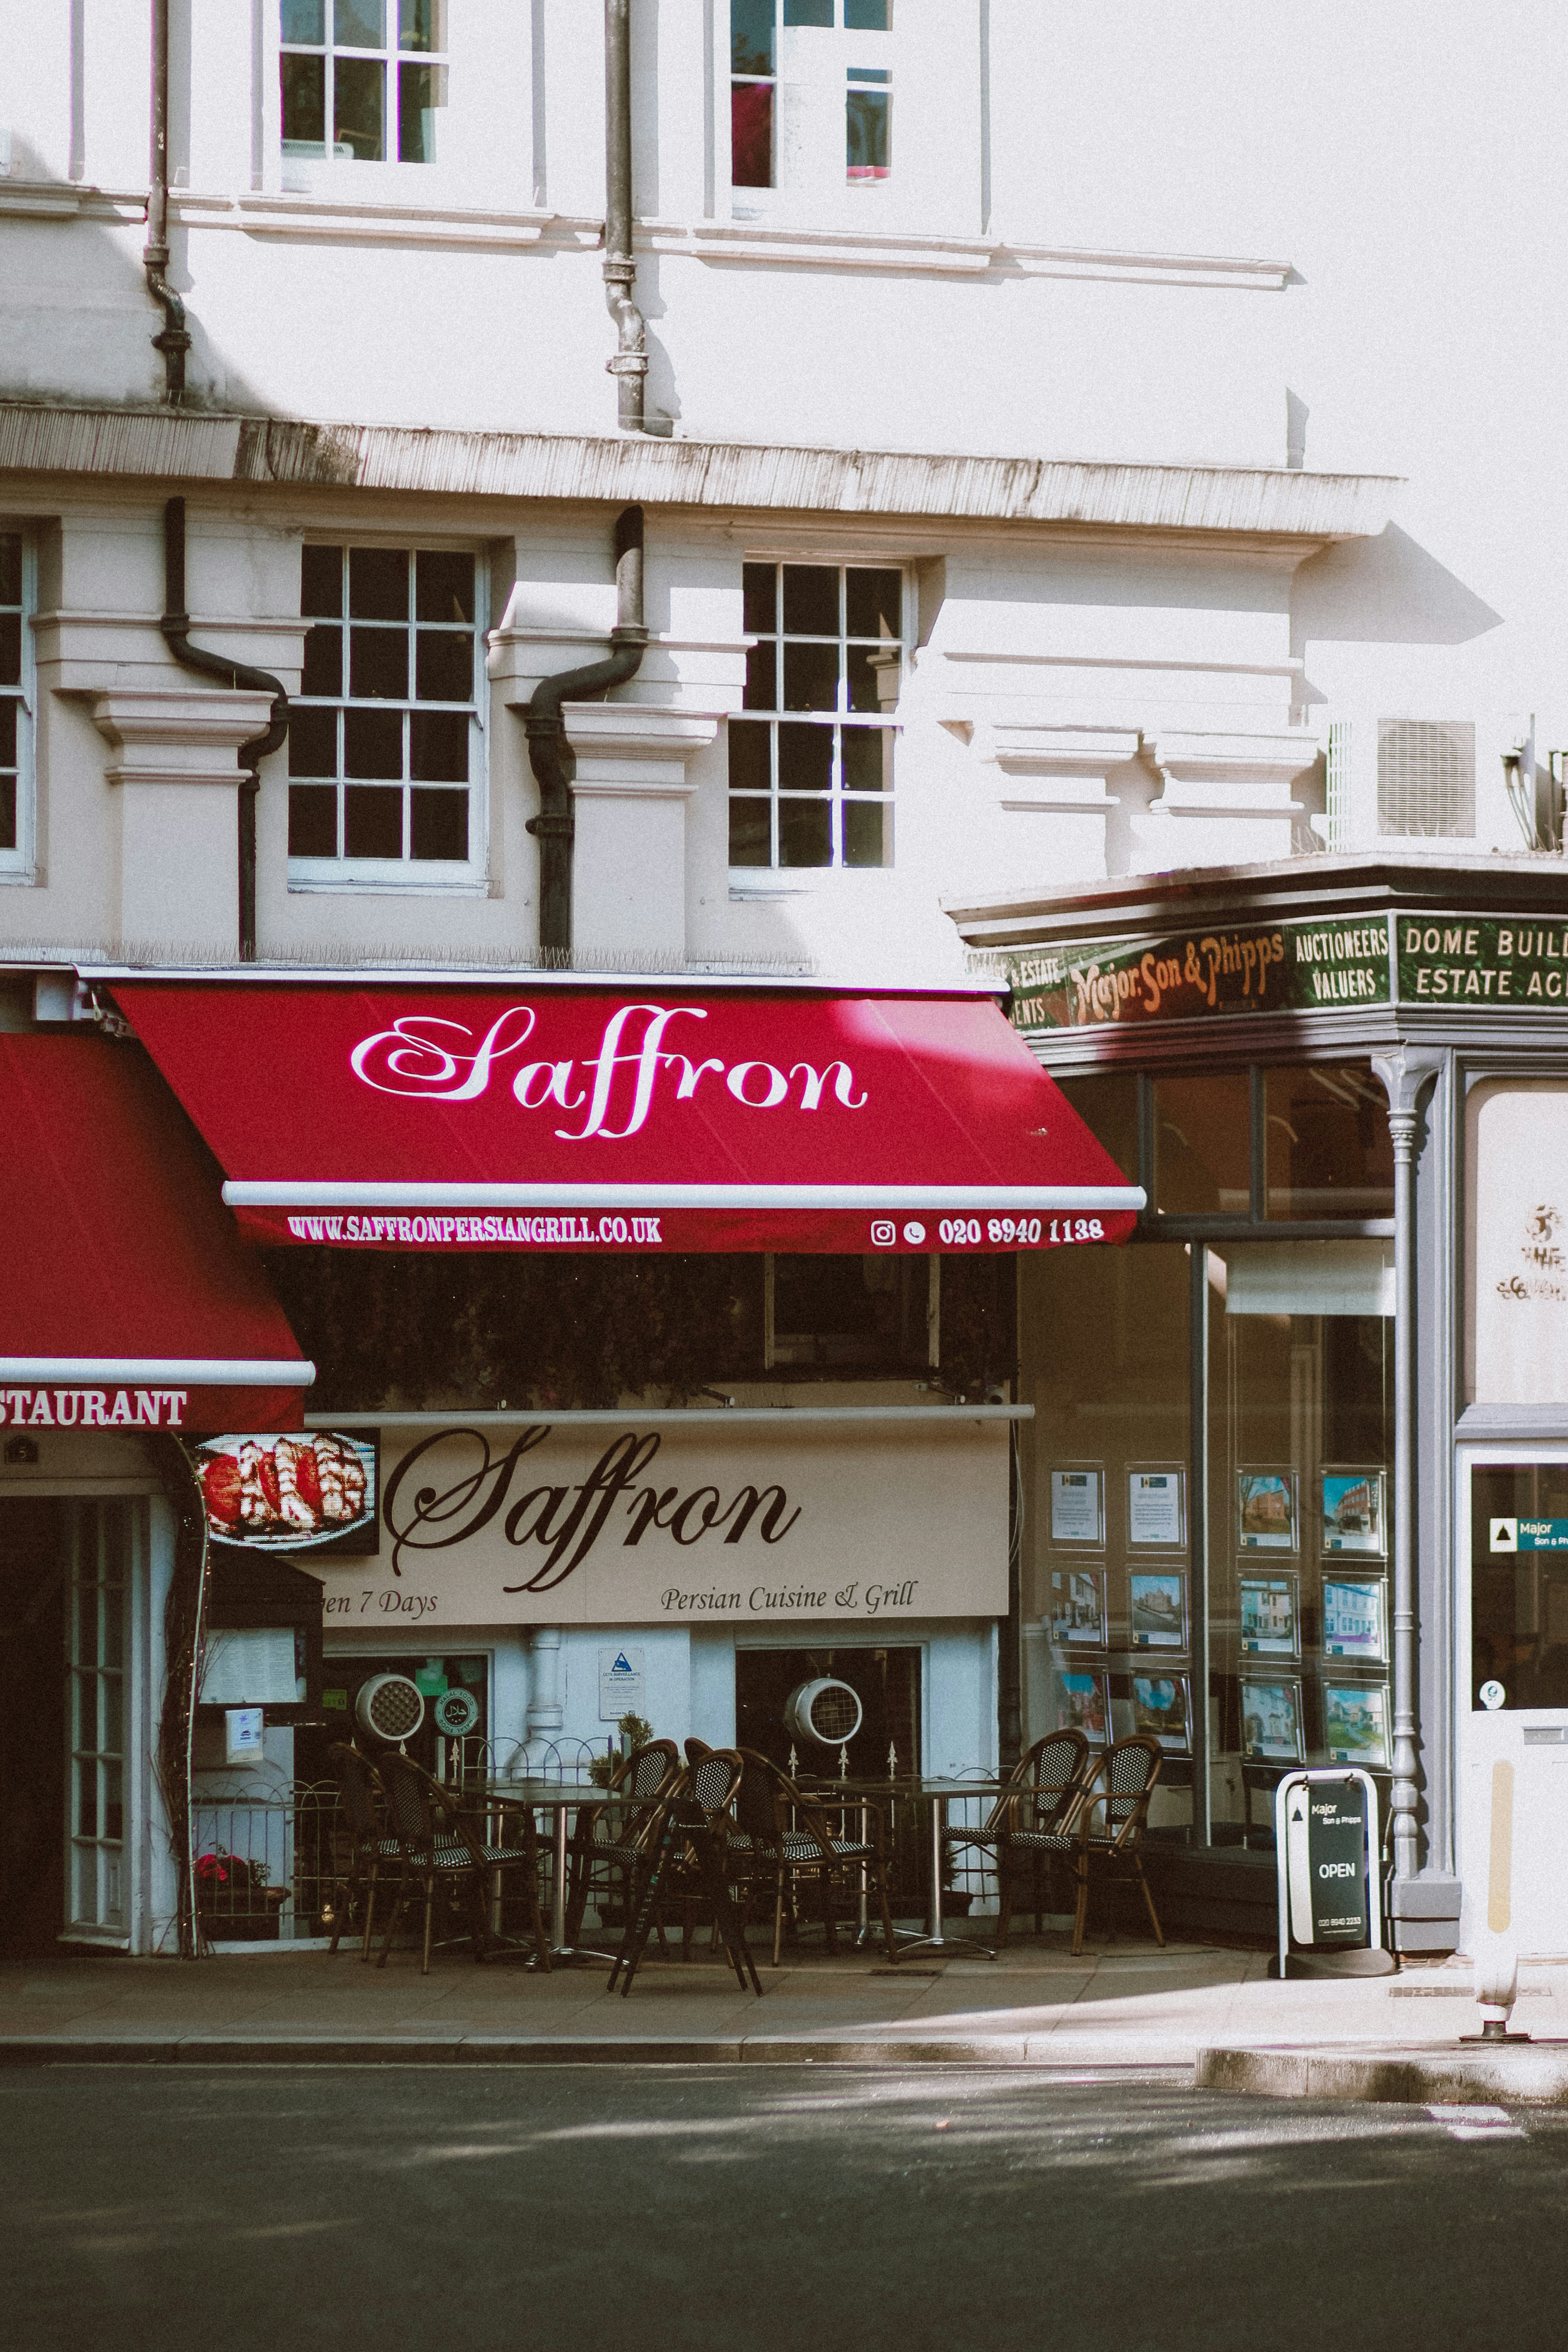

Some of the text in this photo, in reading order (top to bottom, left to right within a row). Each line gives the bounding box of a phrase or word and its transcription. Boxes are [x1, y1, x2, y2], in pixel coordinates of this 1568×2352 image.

[1296, 928, 1388, 962] AUCTIONEERS
[1406, 928, 1480, 955] DOME
[1020, 957, 1061, 988] ESTATE
[1141, 953, 1182, 1012] Son
[1184, 941, 1207, 993] &
[1201, 933, 1283, 1006] Phipps
[1313, 969, 1376, 1000] VALUERS
[1417, 968, 1512, 995] ESTATE
[350, 1004, 868, 1139] Saffron
[287, 1216, 662, 1243] WWW.SAFFRONPERSIANGRILL.CO.UK
[939, 1218, 1105, 1244] 020 8940 1138
[382, 1425, 802, 1593] Saffron
[1520, 1522, 1552, 1536] Major
[1535, 1537, 1550, 1545] Son
[360, 1591, 374, 1613] 7
[379, 1590, 438, 1620] Days
[661, 1580, 919, 1614] Persian Cuisine & Grill
[439, 1692, 474, 1706] HALAL FOOD
[1311, 1804, 1338, 1816] Major
[1319, 1862, 1356, 1879] OPEN
